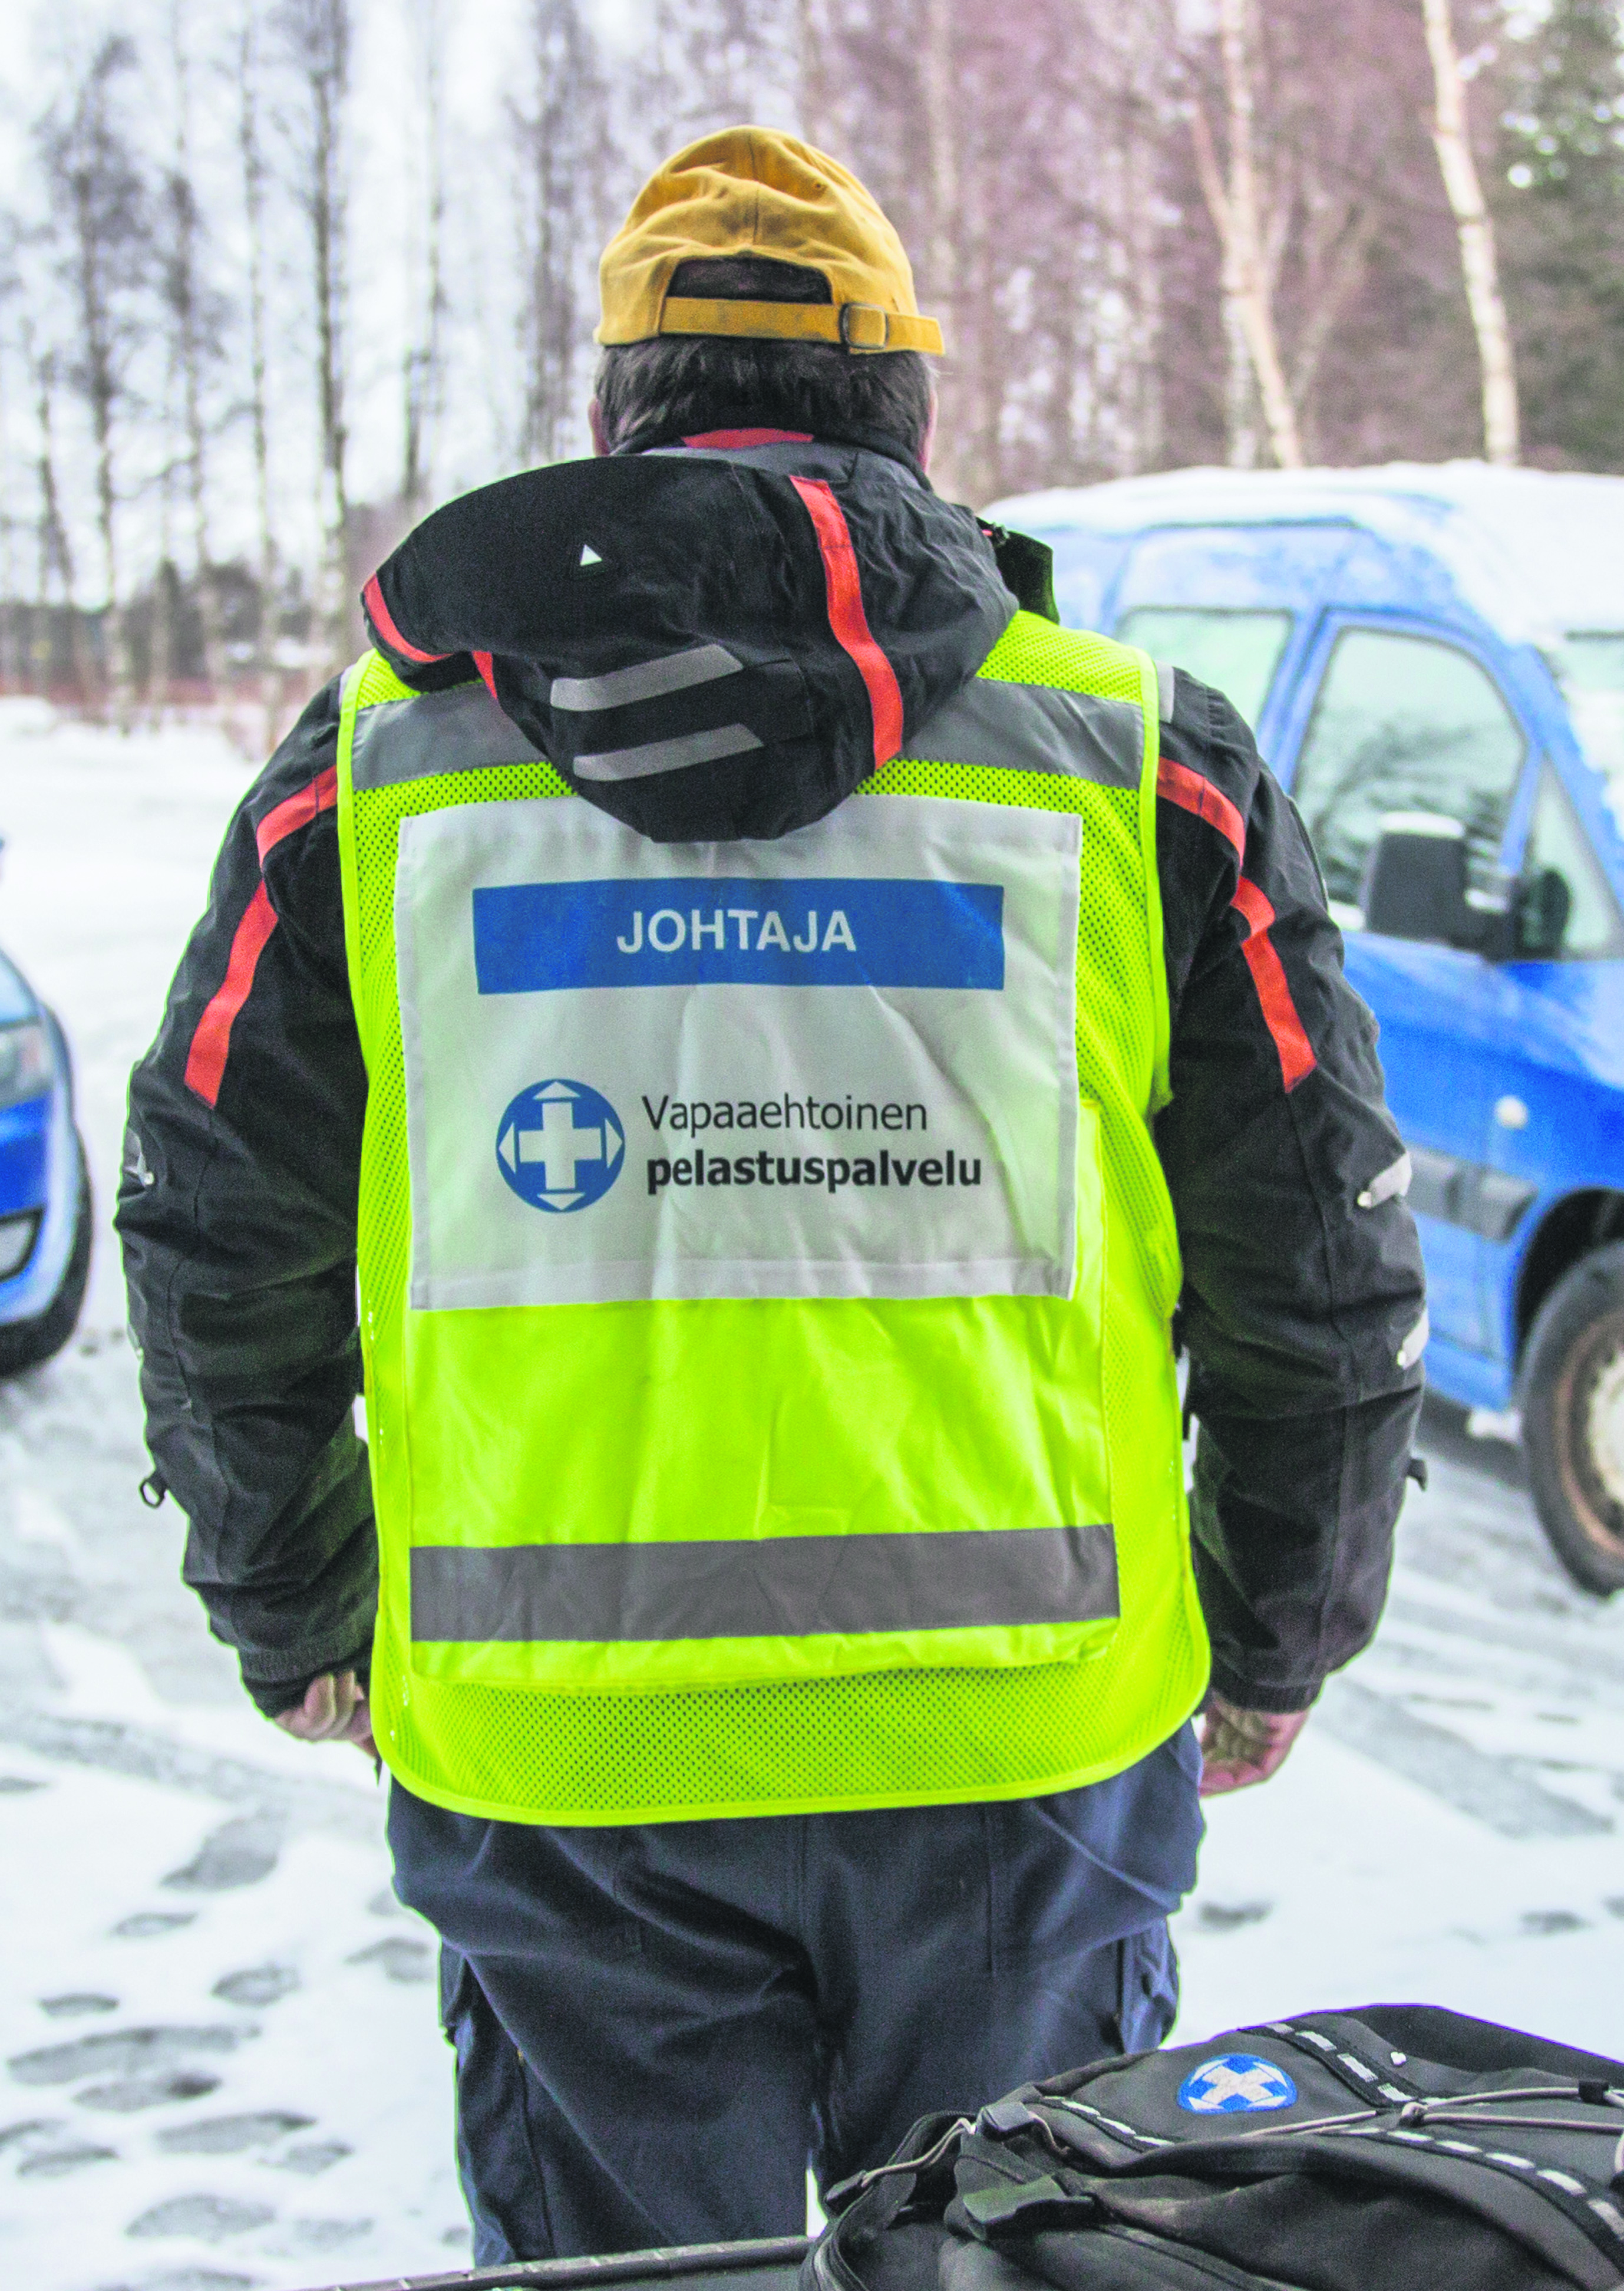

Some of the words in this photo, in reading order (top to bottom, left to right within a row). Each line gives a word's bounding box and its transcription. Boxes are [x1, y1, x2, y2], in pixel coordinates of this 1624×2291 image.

[616, 909, 857, 954] JOHTAJA
[642, 1093, 927, 1138] Vapaaehtoinen
[647, 1149, 981, 1195] pelastuspalvelu
